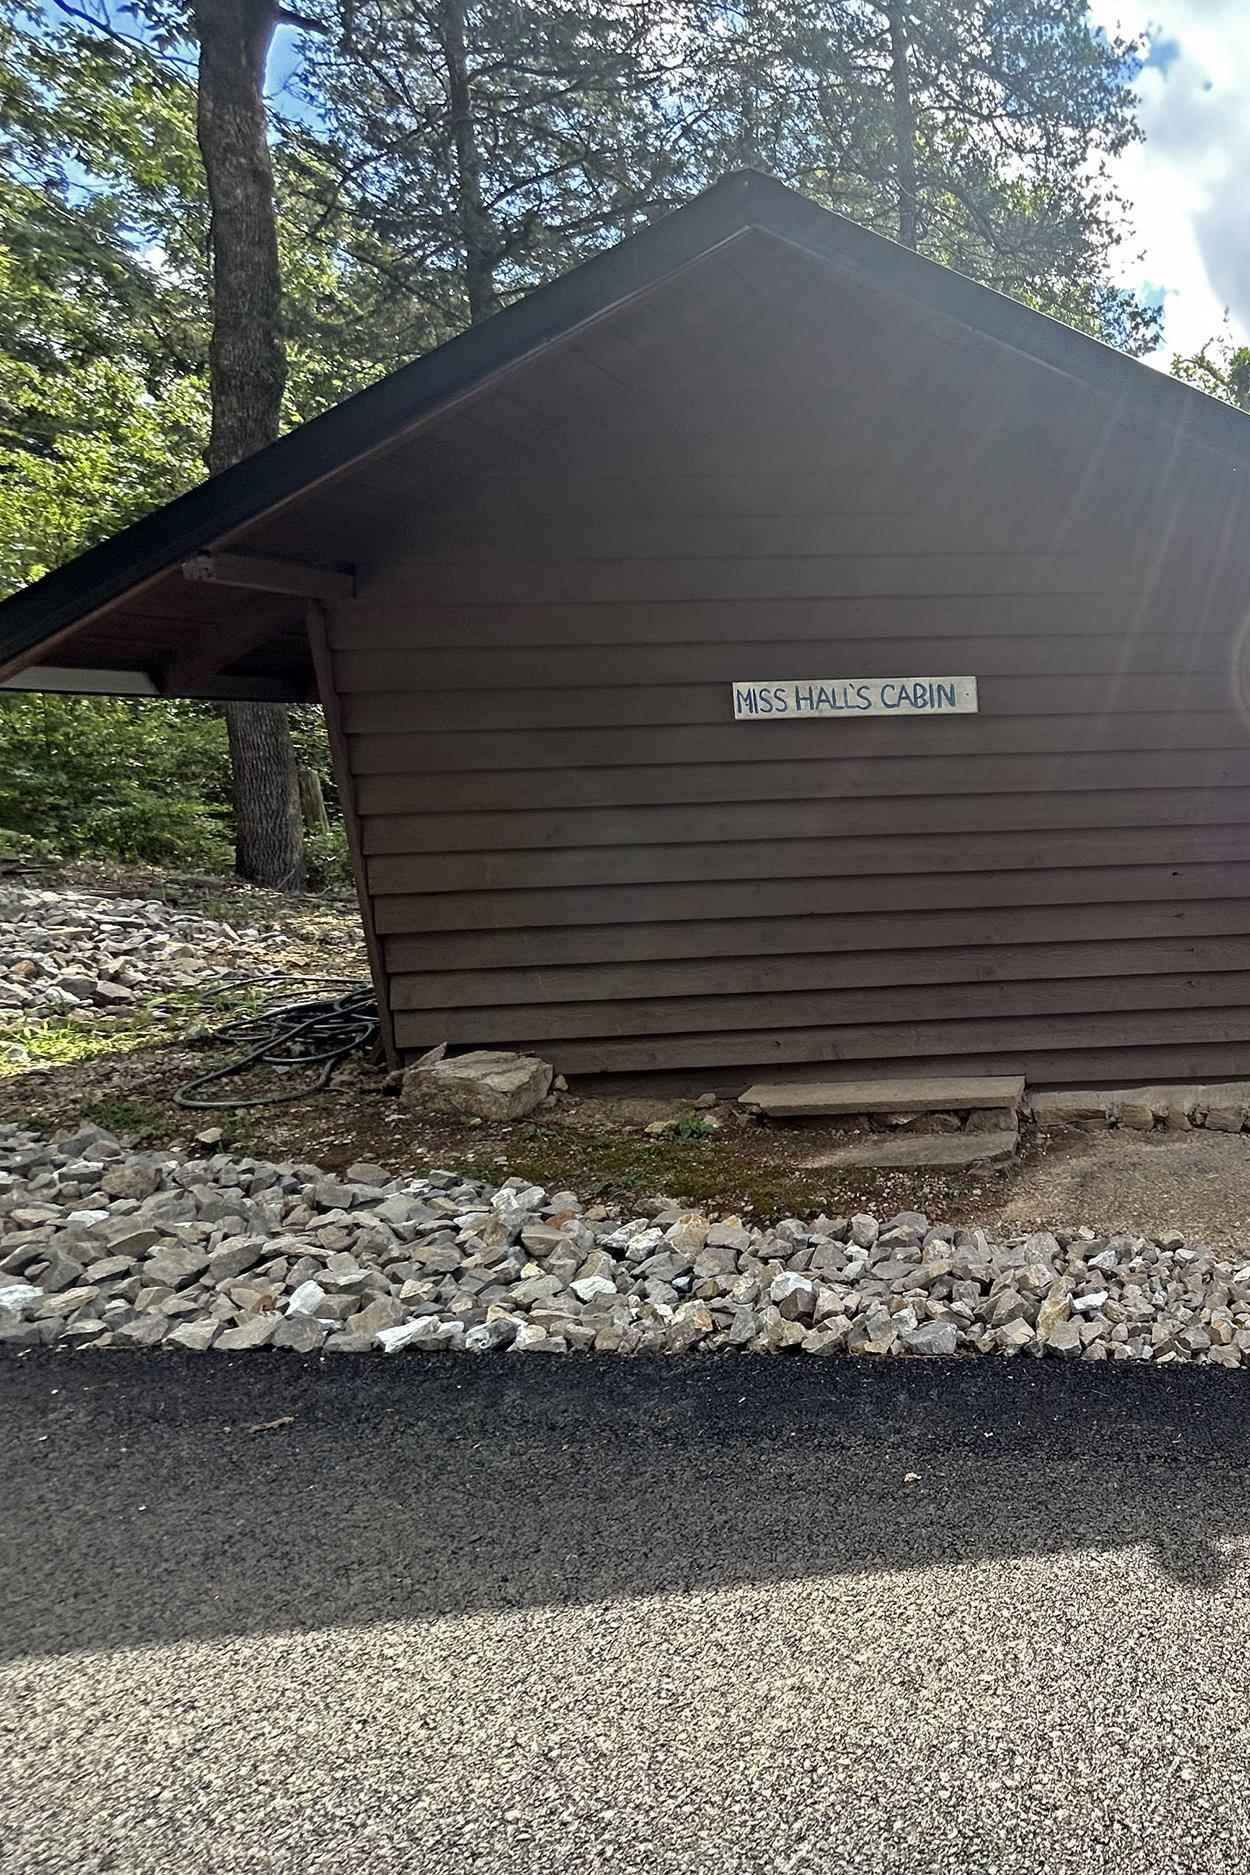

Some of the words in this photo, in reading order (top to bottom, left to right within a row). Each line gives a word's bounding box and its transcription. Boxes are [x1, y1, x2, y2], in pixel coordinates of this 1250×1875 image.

[735, 688, 788, 714] MISS
[795, 682, 872, 711] HALL'S
[880, 682, 956, 709] CABIN
